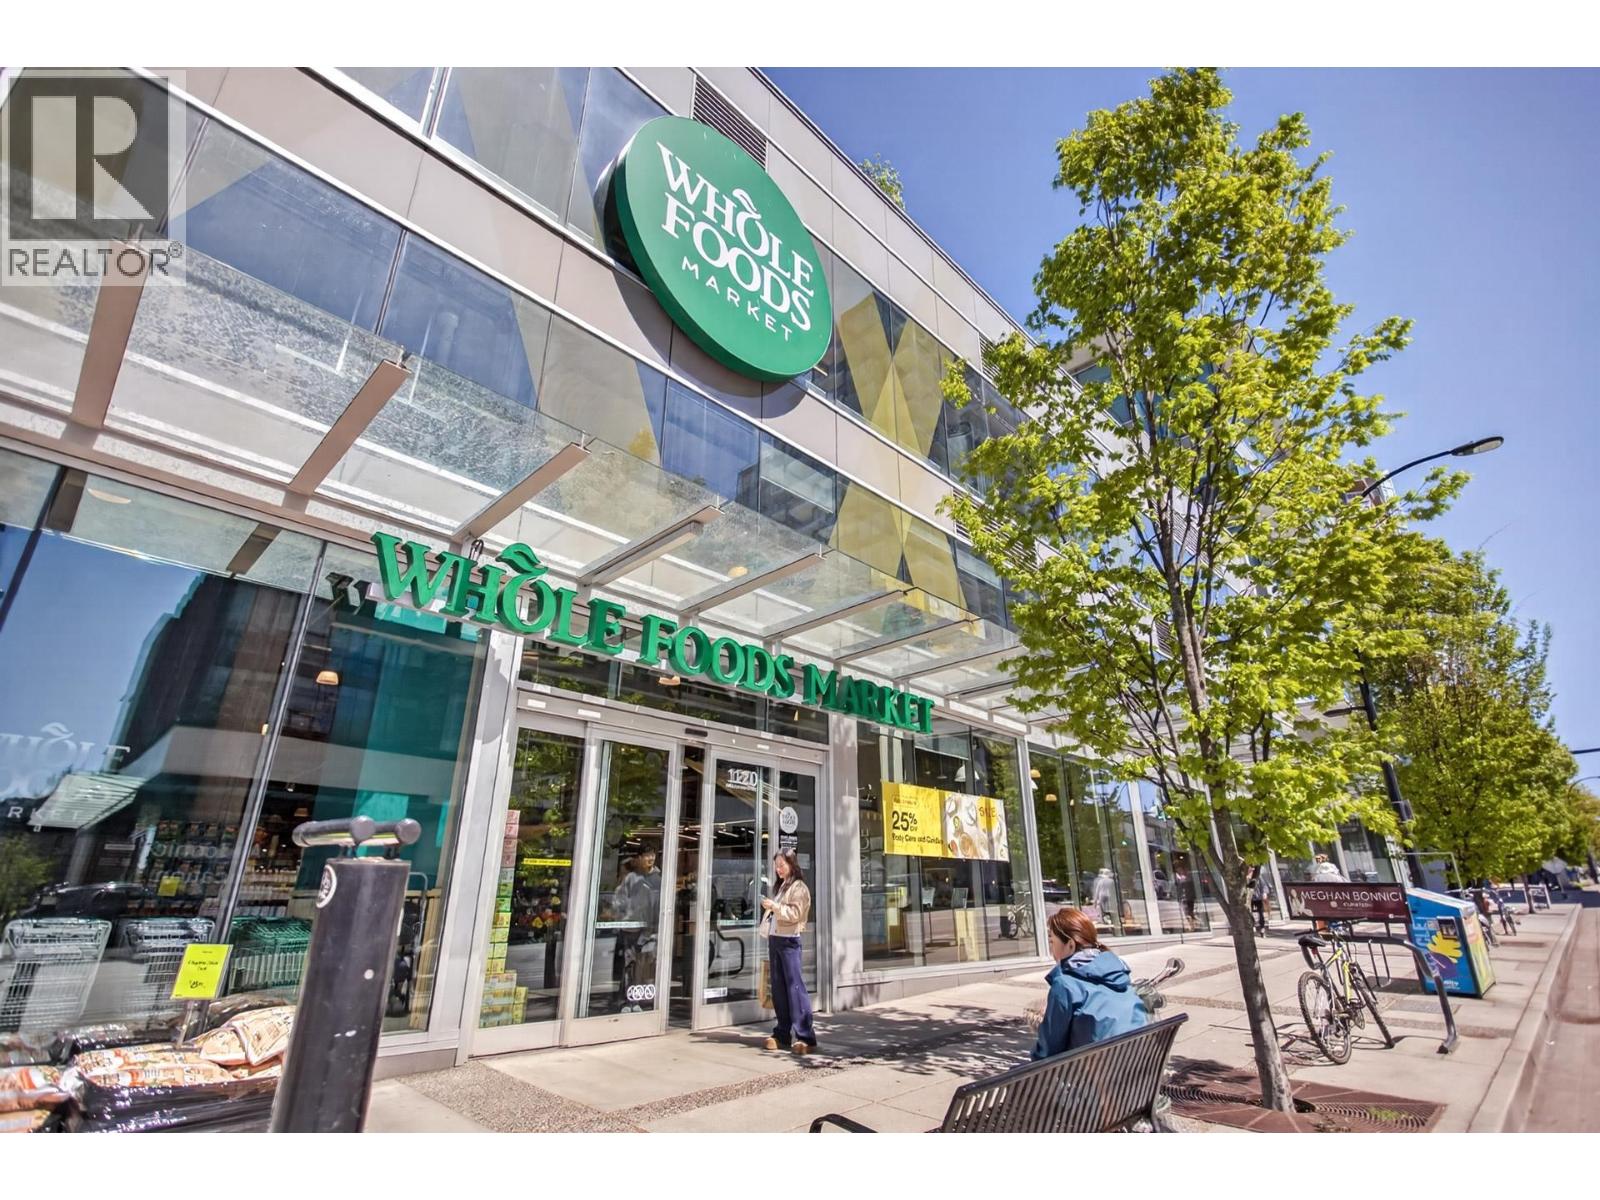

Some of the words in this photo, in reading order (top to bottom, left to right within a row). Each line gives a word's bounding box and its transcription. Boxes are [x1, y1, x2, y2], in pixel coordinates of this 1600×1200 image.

[656, 141, 815, 297] WHOLE
[661, 191, 812, 332] FOODS
[681, 256, 793, 341] MARKET
[370, 531, 627, 656] WHOLE
[635, 613, 796, 700] FOODS
[802, 663, 935, 734] MARKET
[891, 810, 918, 832] 25%
[1300, 890, 1350, 901] MEGHAN
[1352, 891, 1403, 902] BONNICI
